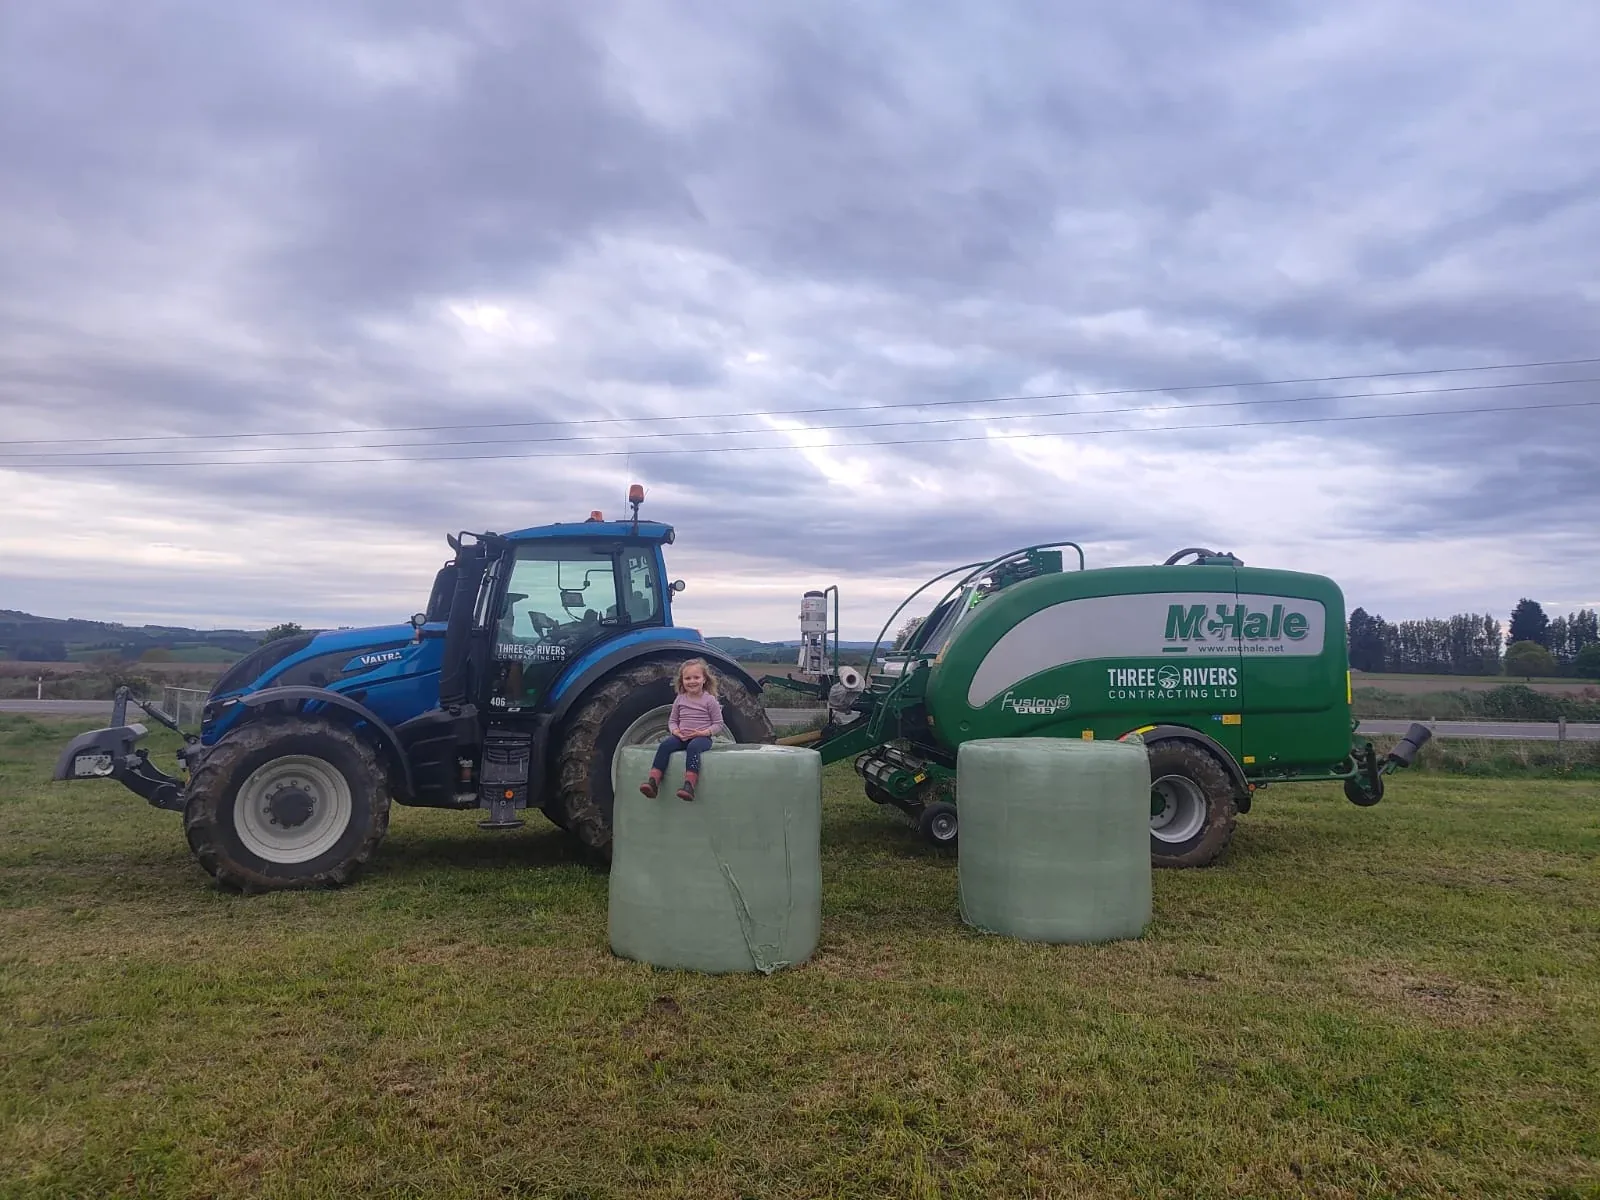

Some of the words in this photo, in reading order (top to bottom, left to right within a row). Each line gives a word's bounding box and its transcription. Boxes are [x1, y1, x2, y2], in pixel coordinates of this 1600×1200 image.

[1164, 604, 1309, 641] McHale
[498, 643, 523, 654] THREE
[537, 645, 566, 655] RIVERS
[1198, 644, 1284, 653] www.mchale.net
[361, 652, 402, 665] VALTRA
[1108, 668, 1156, 687] THREE
[1183, 667, 1238, 686] RIVERS
[1108, 689, 1208, 699] CONTRACTING
[1214, 688, 1238, 698] LTD
[490, 697, 506, 707] 406
